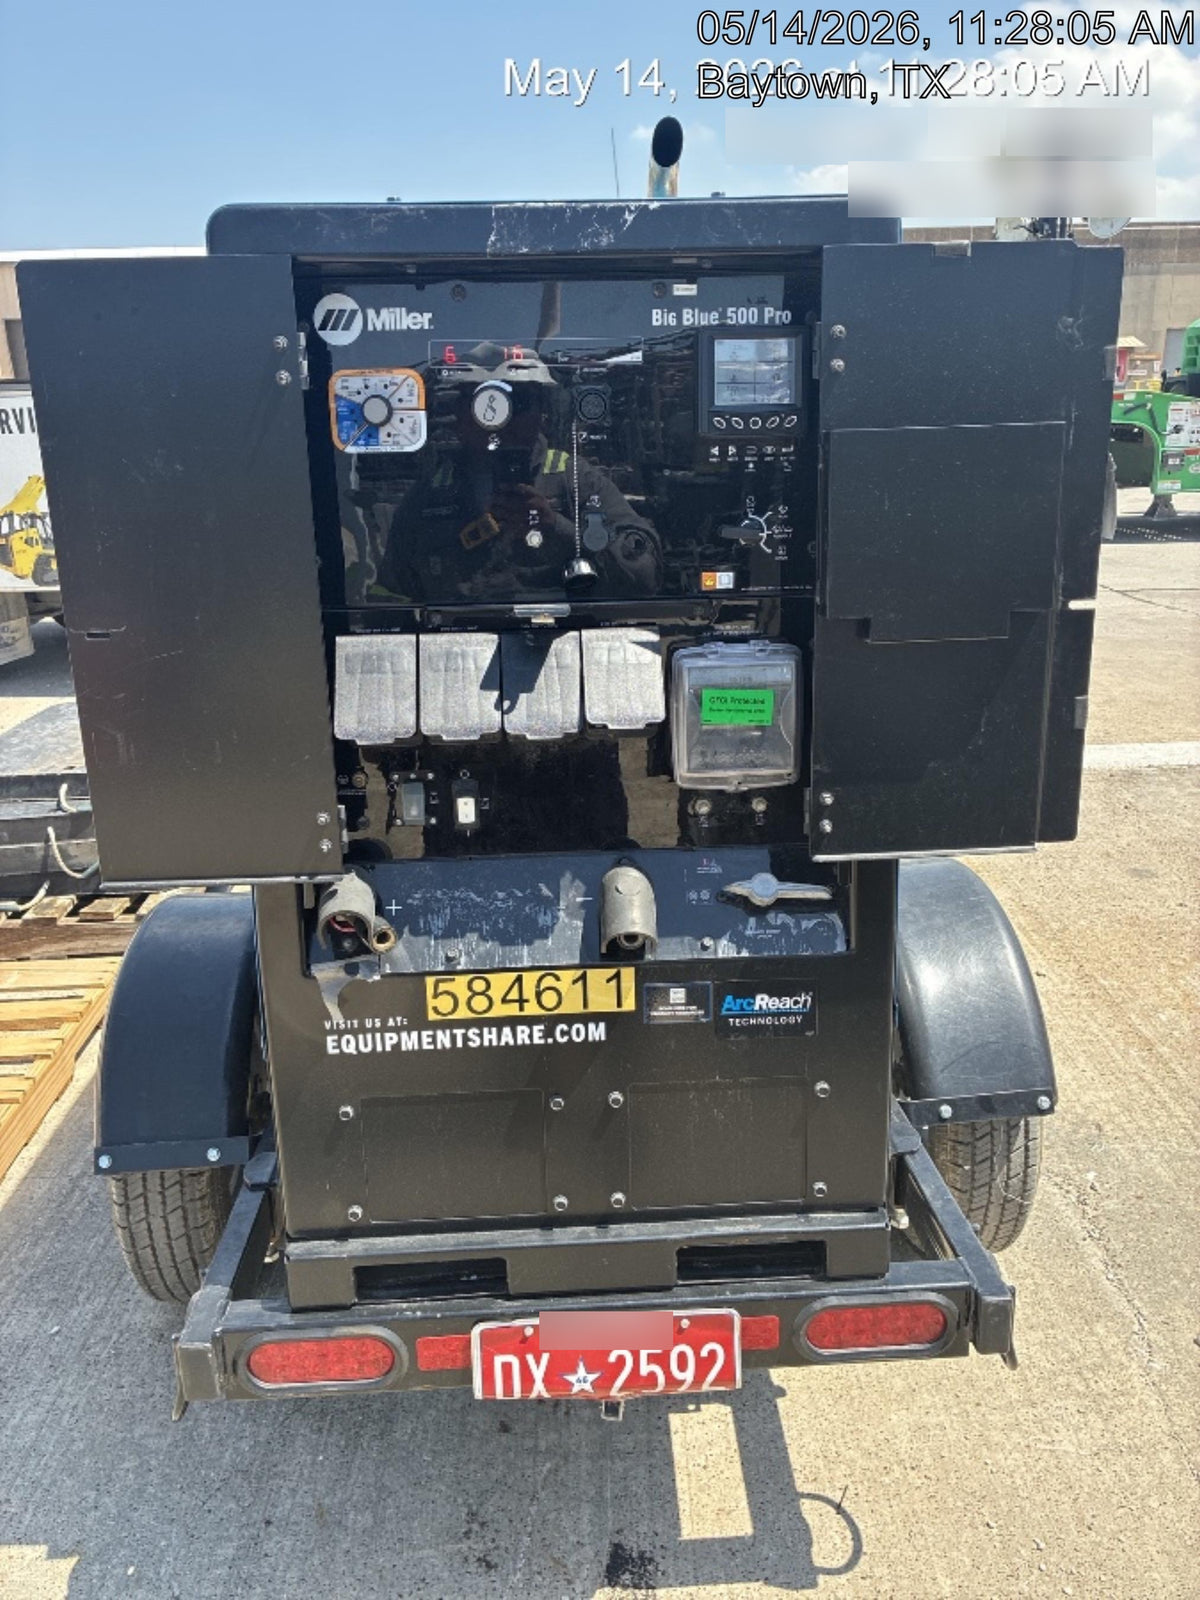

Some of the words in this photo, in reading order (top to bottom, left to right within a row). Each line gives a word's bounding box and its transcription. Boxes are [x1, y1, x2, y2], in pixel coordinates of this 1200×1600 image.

[367, 307, 433, 331] Miller
[682, 308, 720, 326] Blue
[726, 306, 758, 325] 500
[764, 306, 792, 325] Pro
[430, 969, 624, 1017] 584611
[721, 992, 812, 1012] ArcReach
[324, 1018, 359, 1030] VISIT
[365, 1018, 382, 1029] US
[387, 1016, 408, 1028] AT:
[728, 1015, 803, 1027] TECHNOLOGY
[326, 1022, 607, 1055] EQUIPMENTSHARE.COM
[607, 1342, 725, 1396] 2592
